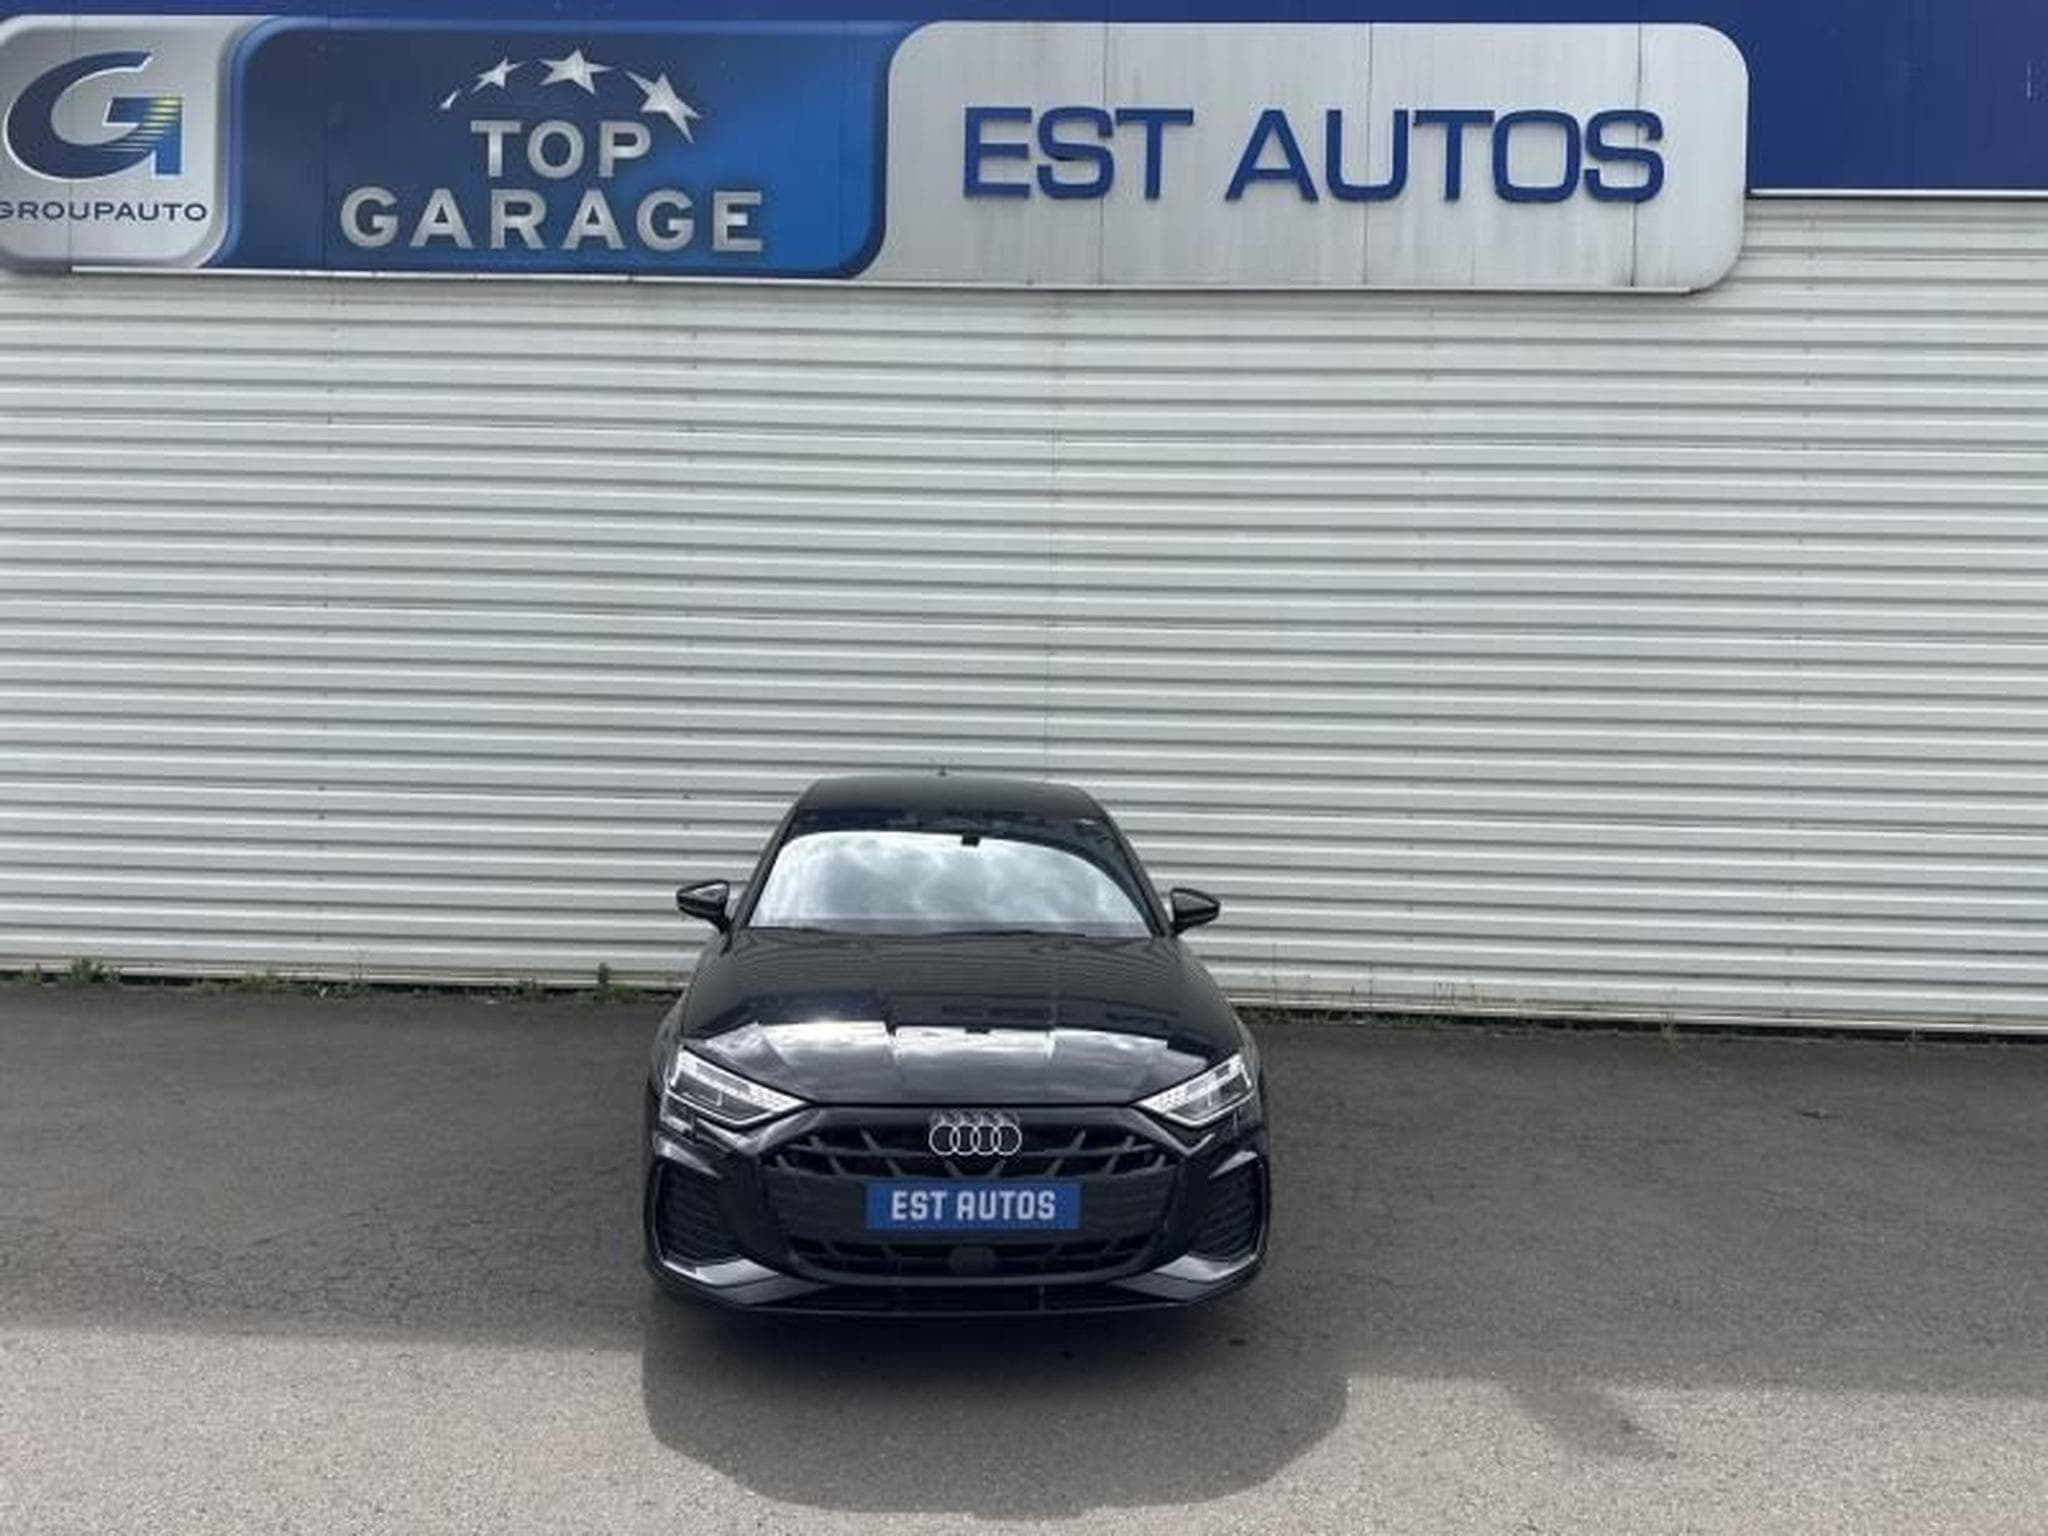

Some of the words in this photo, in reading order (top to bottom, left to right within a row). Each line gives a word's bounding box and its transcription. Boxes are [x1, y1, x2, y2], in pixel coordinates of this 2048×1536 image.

[470, 119, 652, 180] TOP
[963, 106, 1194, 200] EST
[1224, 108, 1666, 203] AUTOS
[0, 200, 208, 222] GROUPAUTO
[339, 186, 763, 253] GARAGE
[891, 1190, 948, 1220] EST
[957, 1190, 1056, 1221] AUTOS
